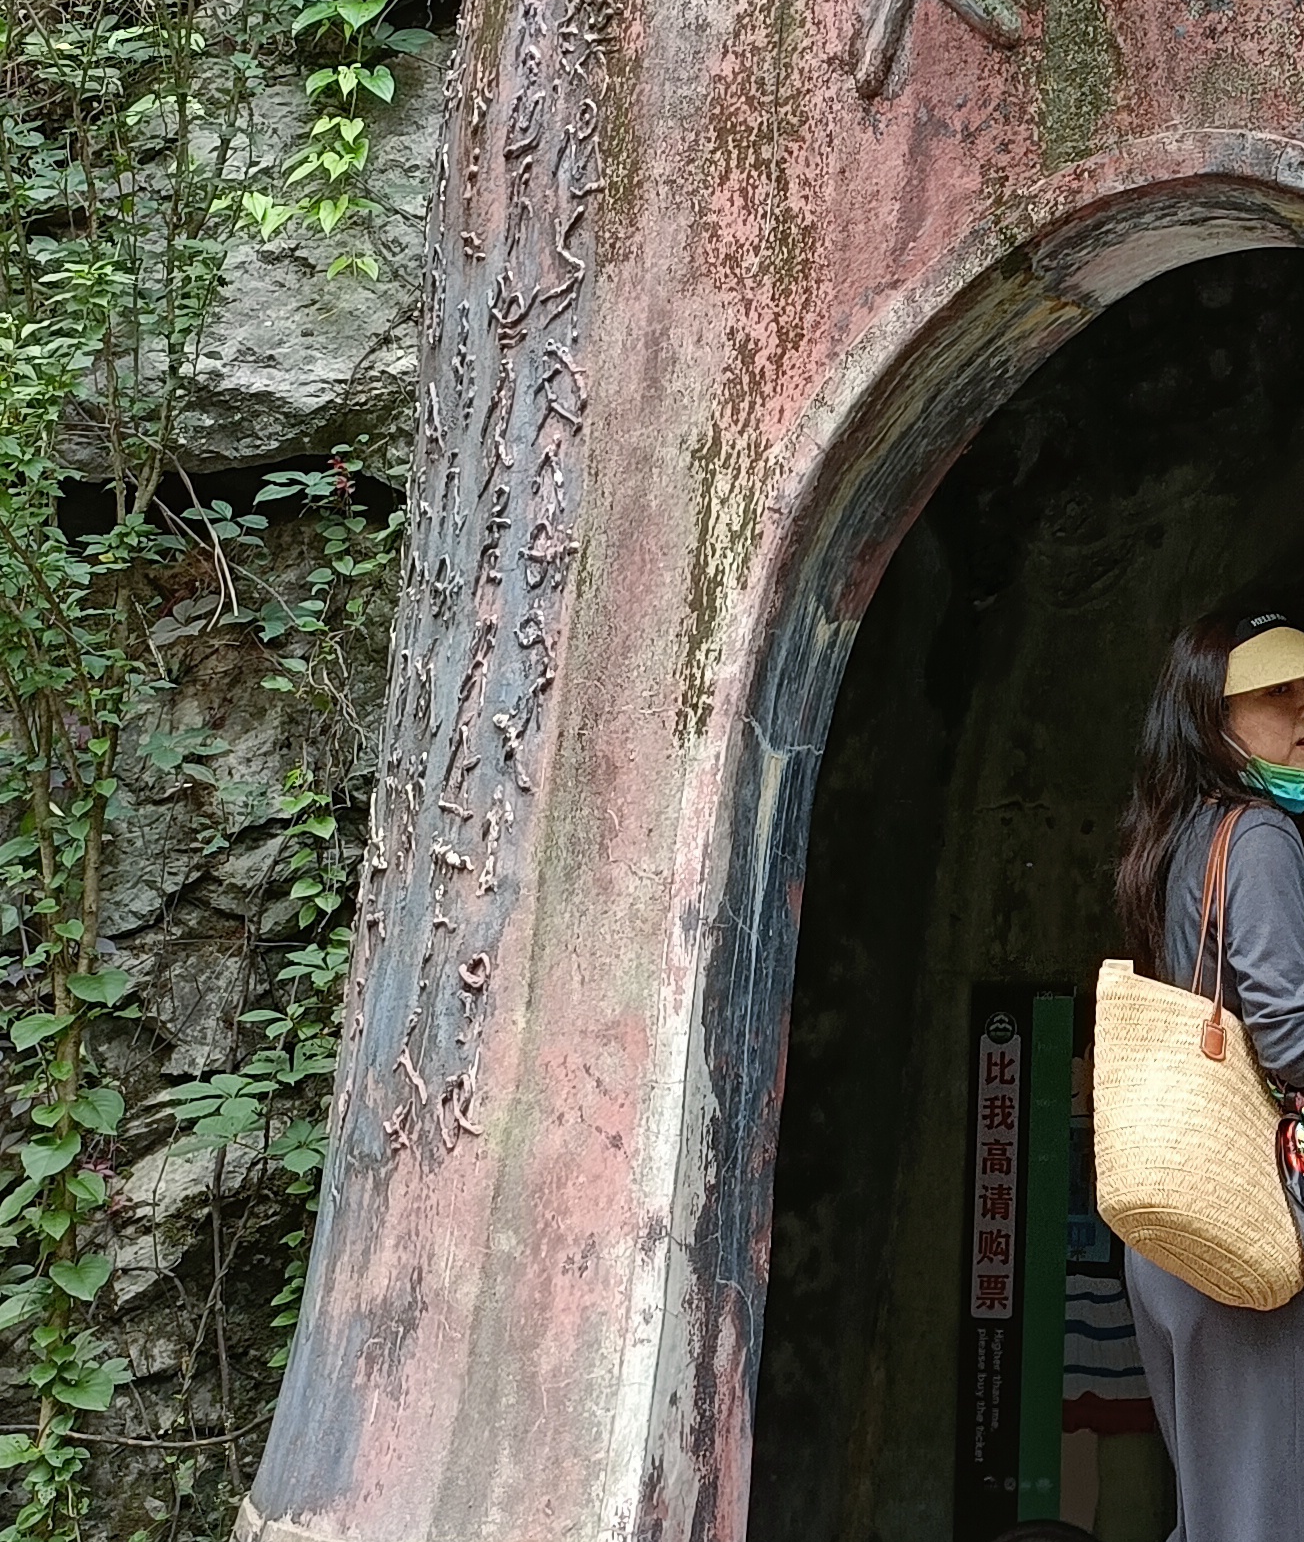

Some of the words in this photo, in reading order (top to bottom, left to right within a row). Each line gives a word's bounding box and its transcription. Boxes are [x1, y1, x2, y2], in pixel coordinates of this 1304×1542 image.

[975, 1050, 1016, 1311] 比我高请购票
[976, 1328, 989, 1371] please
[990, 1328, 1005, 1371] Higher
[975, 1372, 988, 1398] buy
[991, 1374, 1003, 1404] than
[974, 1400, 987, 1423] the
[974, 1425, 986, 1463] ticket
